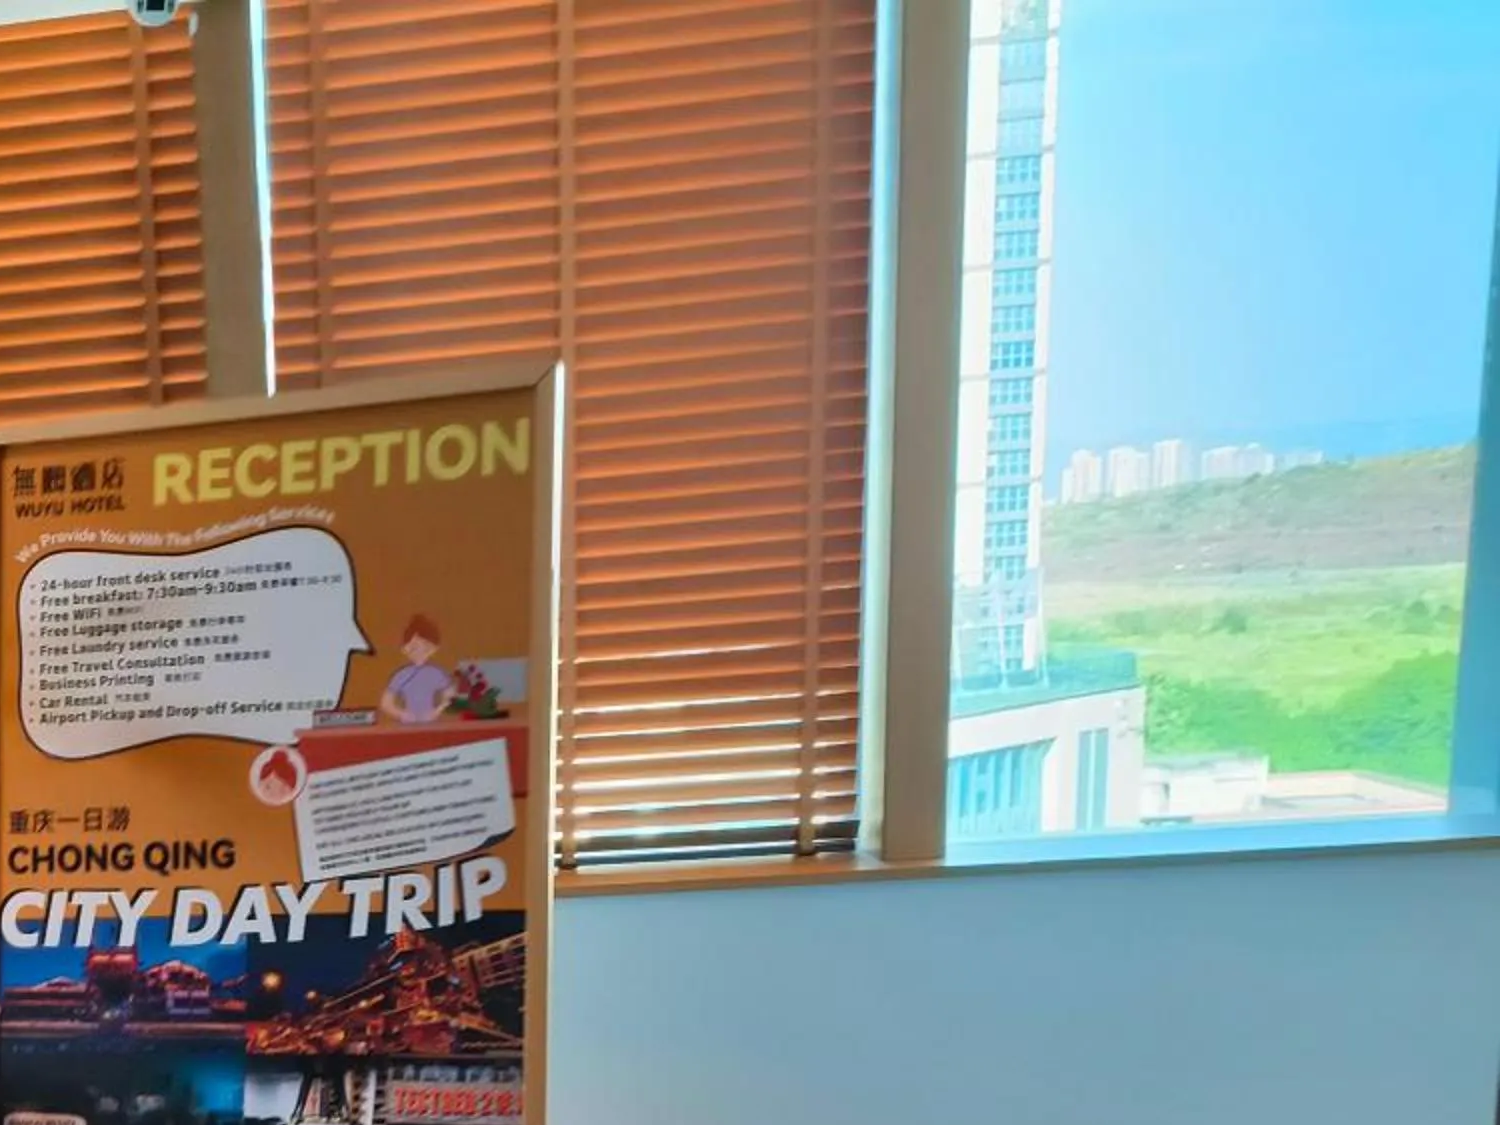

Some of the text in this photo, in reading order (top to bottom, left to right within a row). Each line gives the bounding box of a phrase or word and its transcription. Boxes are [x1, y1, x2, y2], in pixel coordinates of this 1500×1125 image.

[152, 416, 531, 506] RECEPTION
[14, 495, 125, 518] WUYU HOTEL
[13, 542, 40, 563] We
[40, 527, 97, 547] Provide
[100, 529, 125, 545] You
[128, 531, 163, 546] With
[166, 532, 193, 546] The
[40, 578, 94, 592] 24-hour
[96, 575, 132, 587] front
[135, 570, 166, 584] desk
[171, 566, 220, 580] service
[41, 595, 69, 608] Free
[147, 580, 257, 600] 7:30am-9:30am
[40, 611, 69, 623] Free
[40, 625, 69, 637] Free
[72, 623, 127, 637] Luggage
[131, 618, 183, 632] storage
[40, 645, 69, 656] Free
[72, 640, 125, 654] Laundry
[129, 636, 179, 651] service
[40, 663, 69, 675] Free
[72, 660, 115, 673] Travel
[117, 653, 205, 670] Consultation
[40, 677, 97, 691] Business
[100, 673, 155, 687] Printing
[40, 697, 61, 709] Car
[64, 693, 108, 707] Rental
[40, 711, 87, 726] Airport
[90, 708, 136, 722] Pickup
[139, 705, 163, 718] and
[165, 701, 227, 719] Drop-off
[230, 699, 283, 715] Service
[8, 806, 131, 834] 重庆一日游
[8, 838, 236, 876] CHONG QING
[0, 856, 508, 947] CITY DAY TRIP
